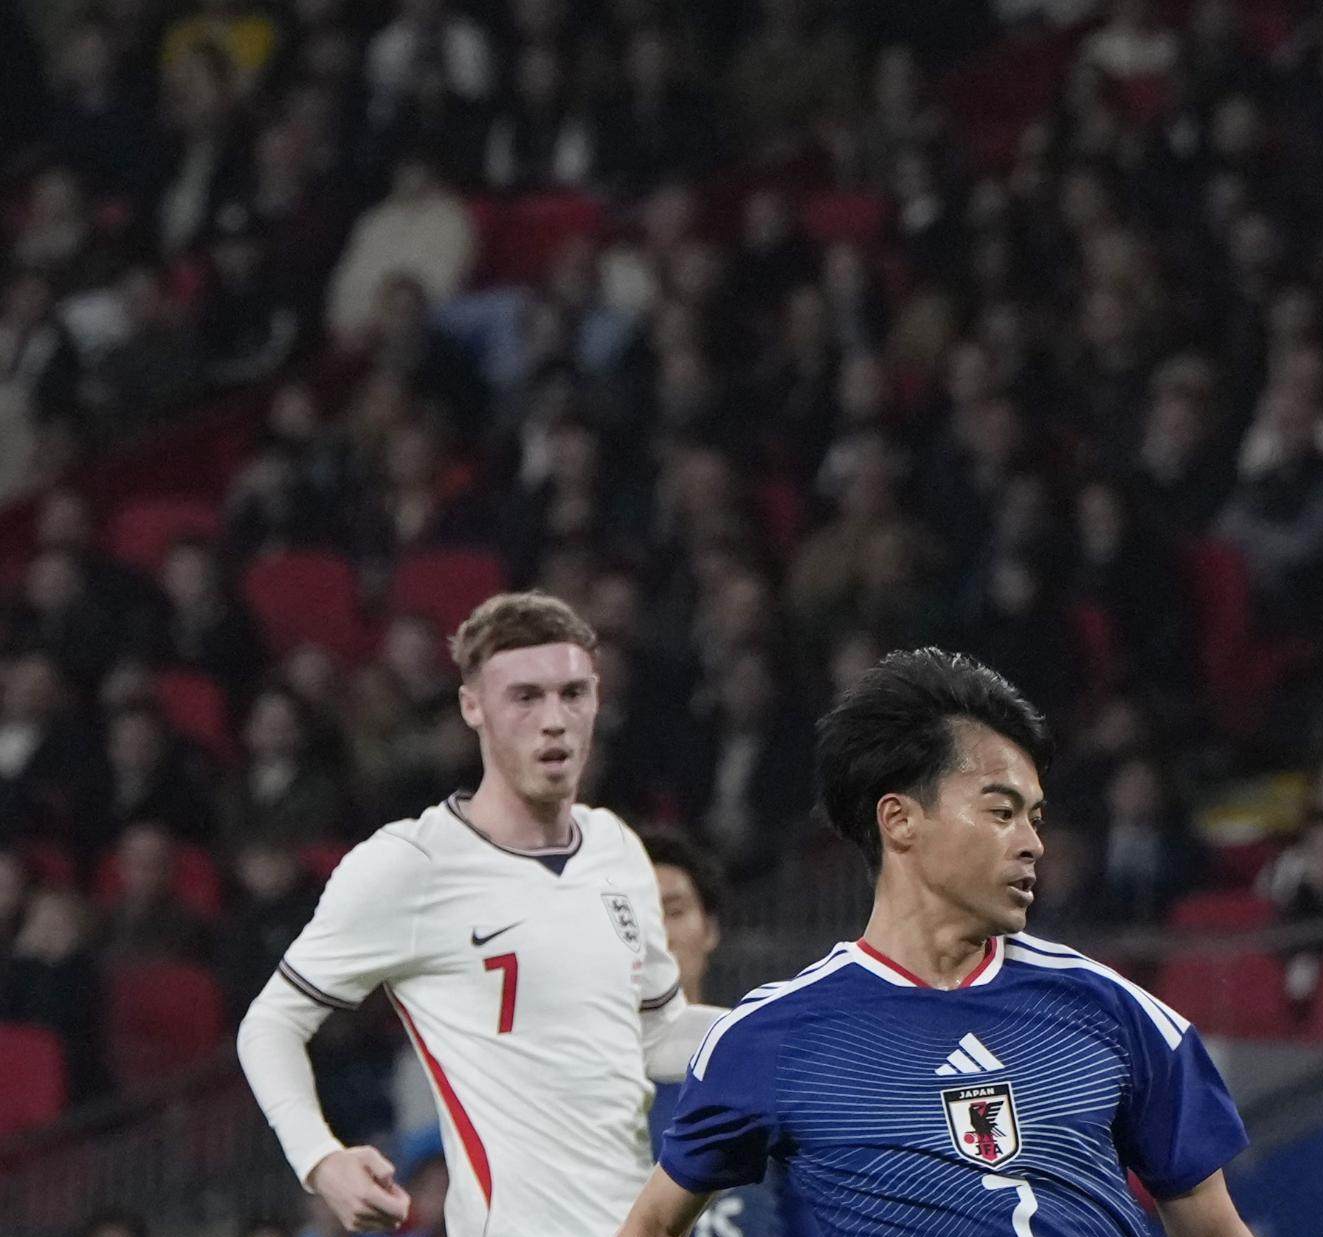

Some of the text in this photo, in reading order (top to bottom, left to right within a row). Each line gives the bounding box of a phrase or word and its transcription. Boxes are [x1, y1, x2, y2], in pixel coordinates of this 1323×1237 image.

[483, 953, 518, 1033] 7
[959, 1087, 995, 1099] JAPAN
[975, 1143, 1003, 1156] JFA
